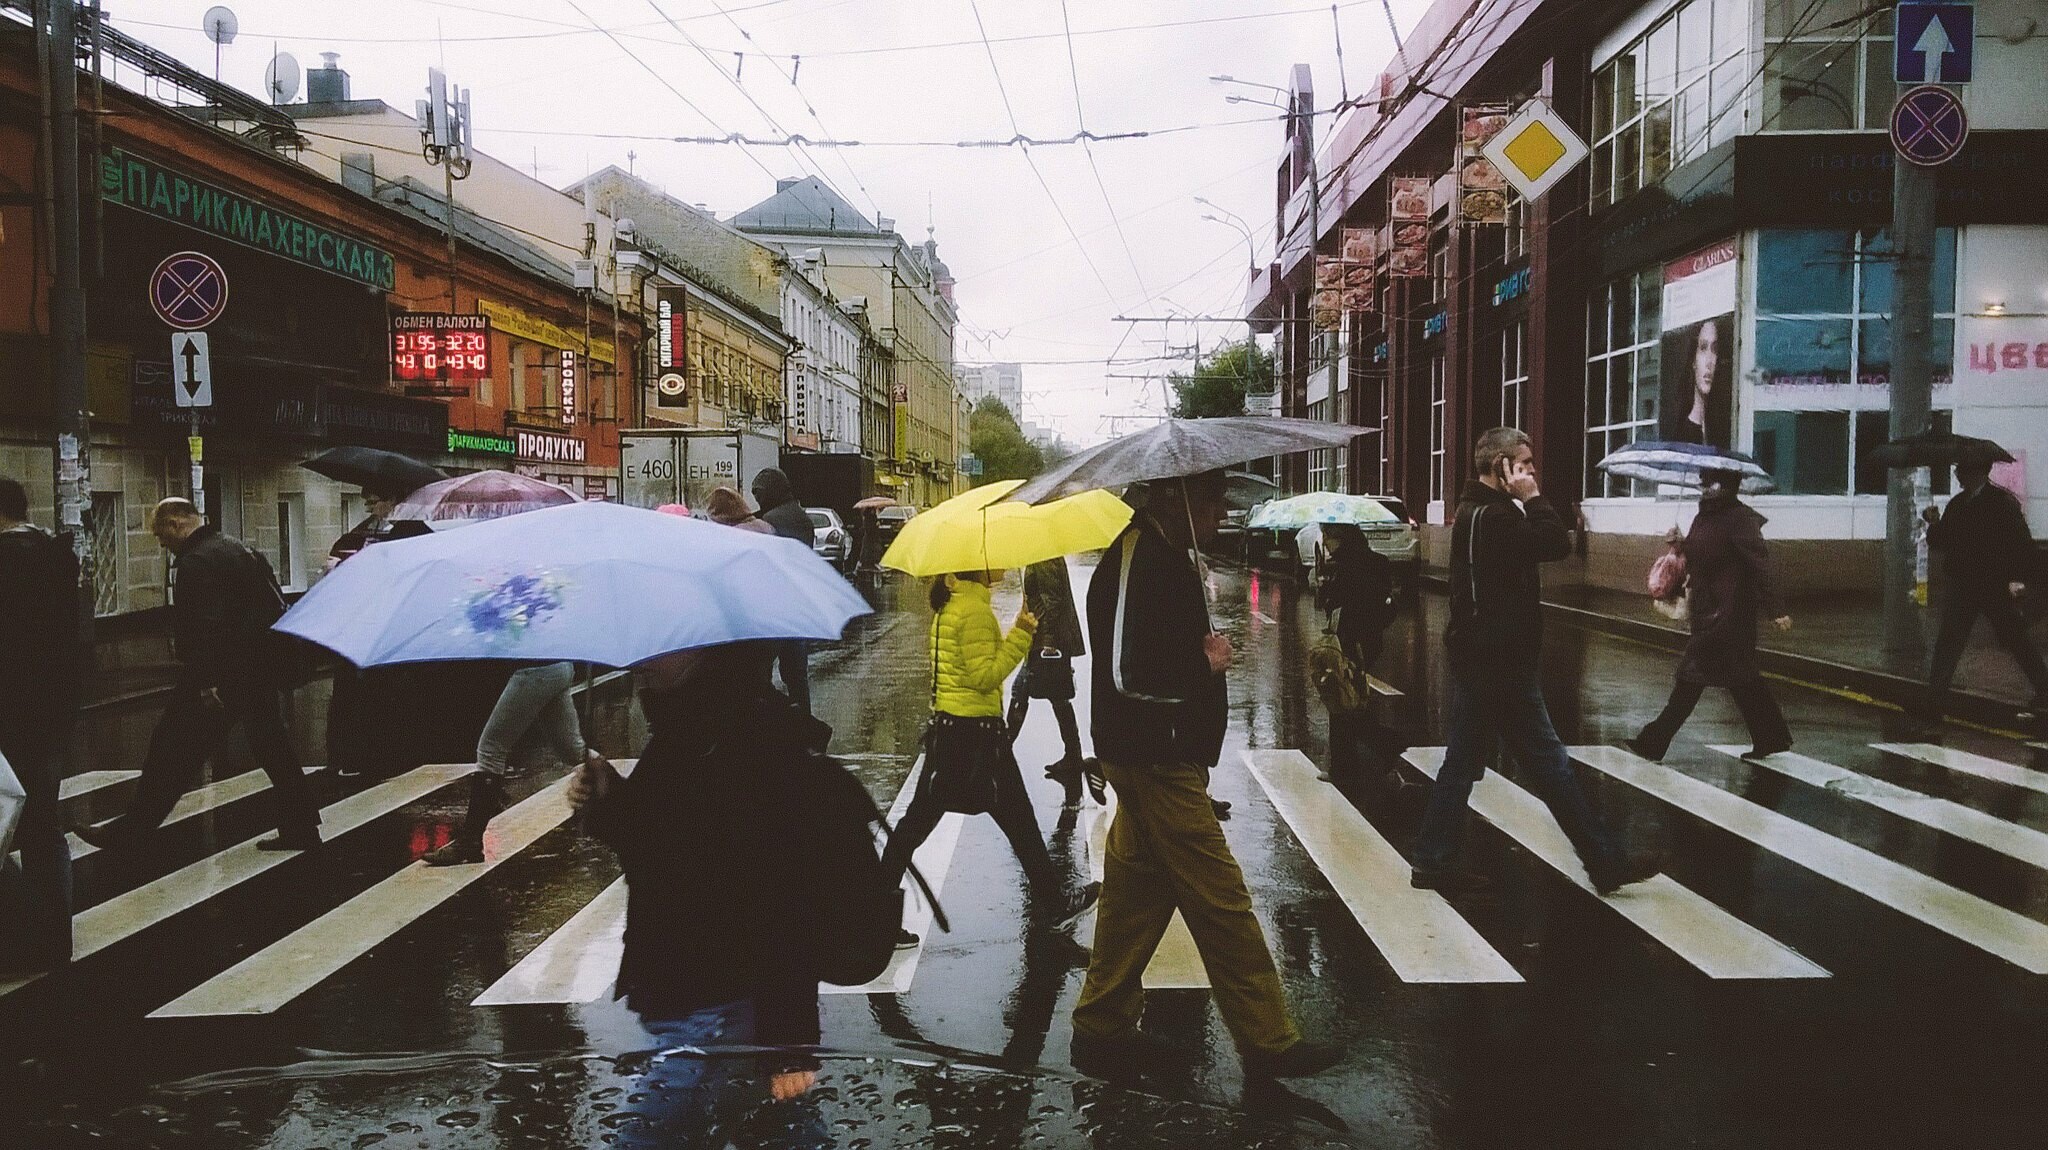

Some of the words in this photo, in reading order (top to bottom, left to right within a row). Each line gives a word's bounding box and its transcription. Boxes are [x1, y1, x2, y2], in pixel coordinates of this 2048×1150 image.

[127, 160, 375, 282] ПАРИКМАХЕРСКАЯ
[1693, 247, 1734, 272] CLARINS
[394, 316, 433, 329] ОБМЕН
[436, 316, 486, 329] ВАЛЮТЫ
[659, 300, 672, 318] БАР
[658, 319, 672, 368] СИГАРНЫЙ
[562, 350, 574, 424] ПРОДУКТЫ
[796, 375, 806, 435] ПИВНИЦА
[518, 433, 585, 462] ПРОДУКТЫ
[641, 459, 673, 479] 460
[715, 461, 733, 472] 199
